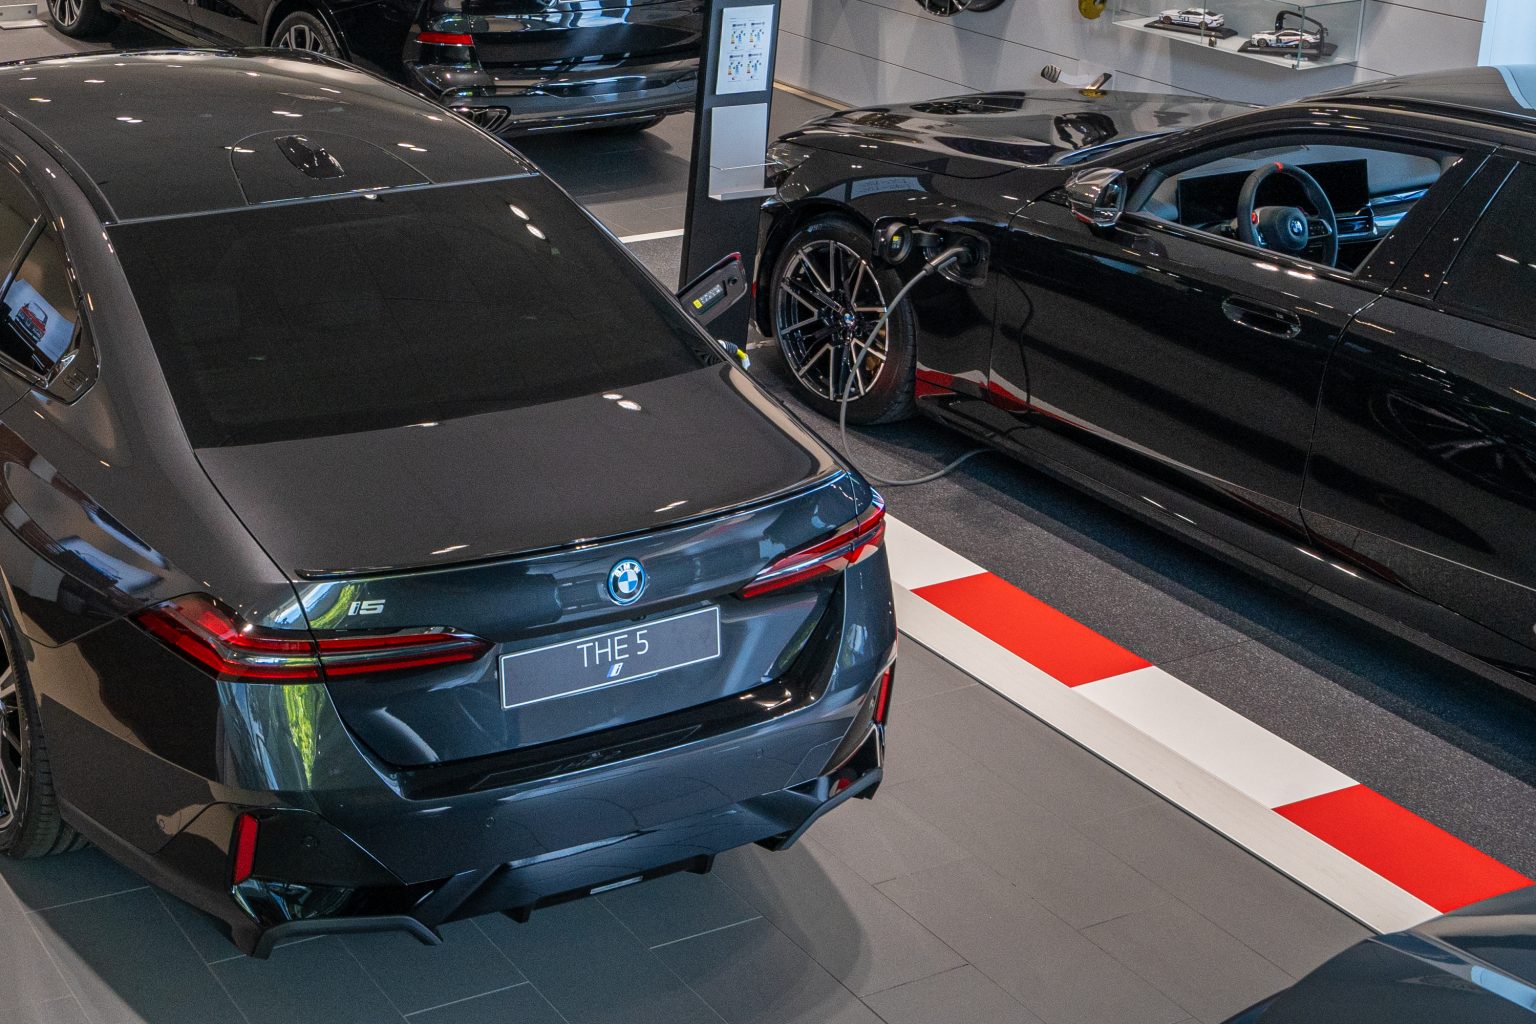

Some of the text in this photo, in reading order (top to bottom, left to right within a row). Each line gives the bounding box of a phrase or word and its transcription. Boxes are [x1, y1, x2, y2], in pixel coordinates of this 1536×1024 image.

[348, 599, 386, 615] i5
[576, 629, 649, 668] THE 5
